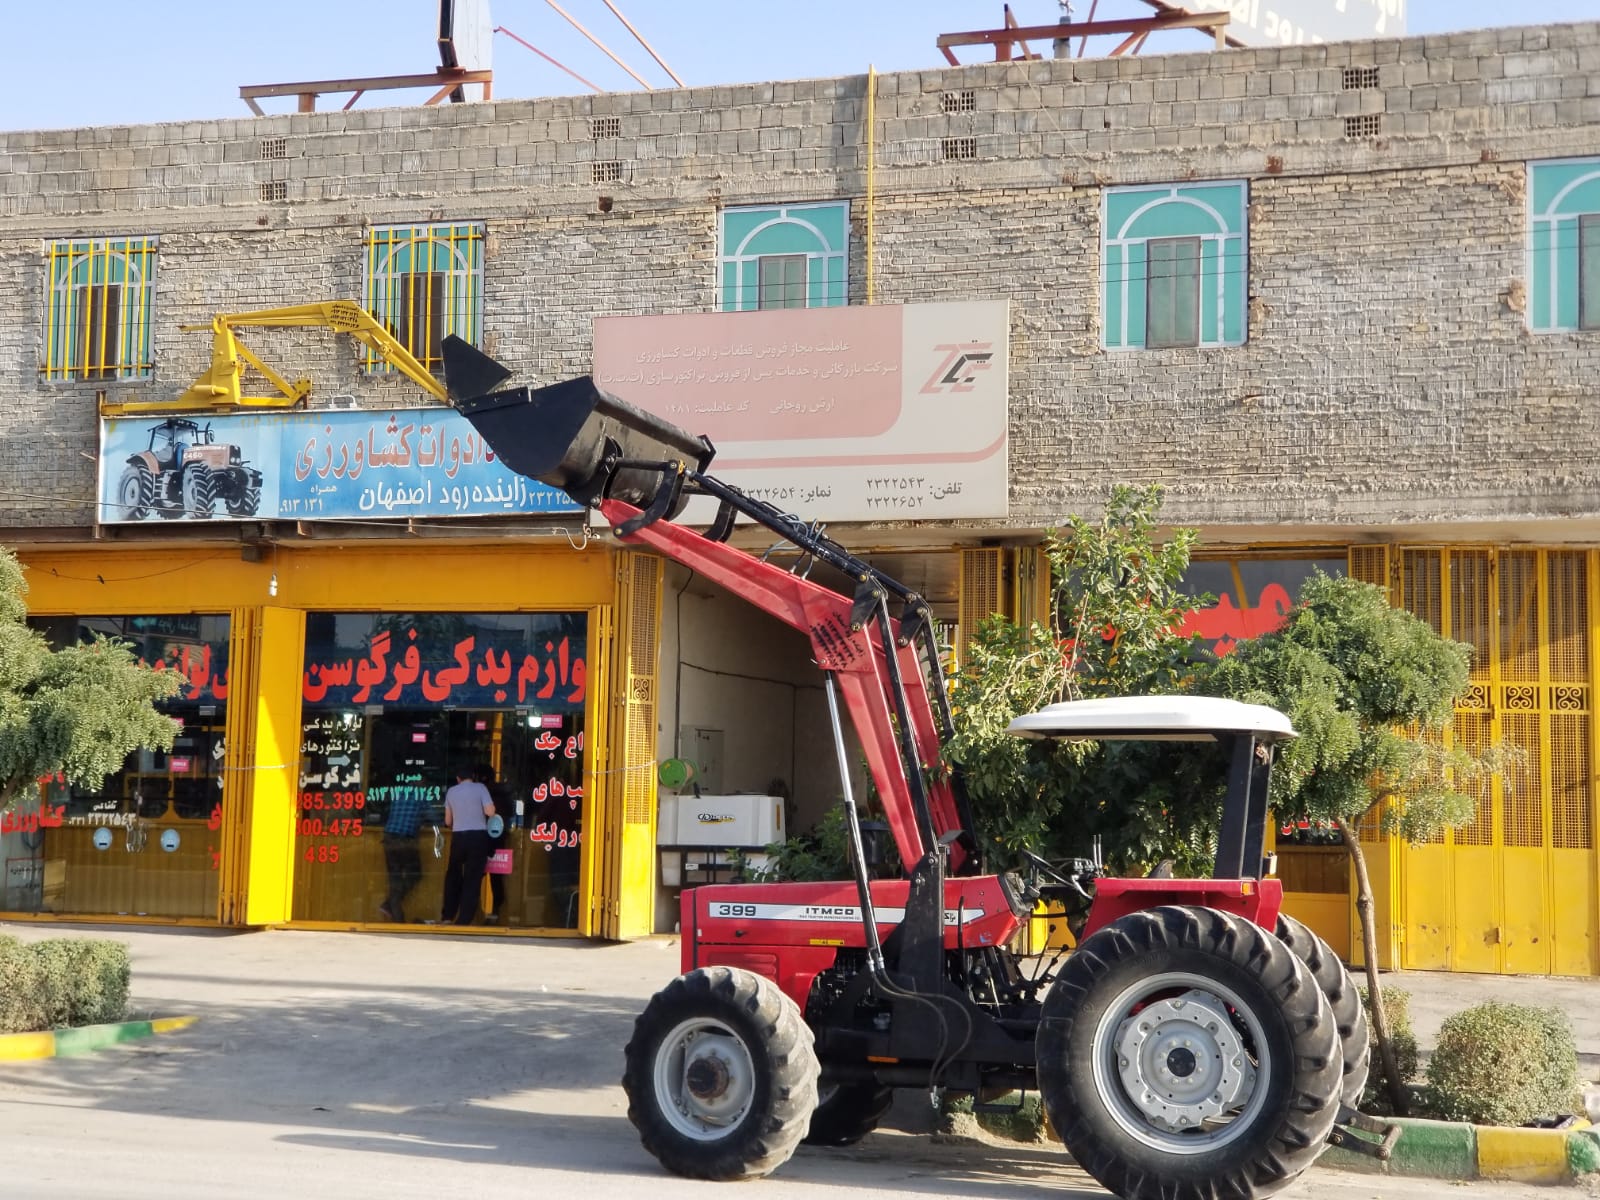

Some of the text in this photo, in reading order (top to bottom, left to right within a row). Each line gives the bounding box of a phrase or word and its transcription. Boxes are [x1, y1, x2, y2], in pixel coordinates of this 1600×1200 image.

[636, 346, 681, 363] کشاورزی
[684, 346, 711, 360] ادوات
[755, 343, 787, 359] فروش
[791, 342, 813, 357] مجاز
[709, 369, 740, 383] فروش
[742, 367, 751, 381] از
[775, 365, 810, 376] خدمات
[821, 361, 861, 379] بازرگانی
[737, 399, 752, 412] کد
[295, 414, 415, 481] کشاورزی
[310, 484, 338, 496] همراه
[866, 477, 925, 491] ۲۳۲۲۵۴۳
[929, 482, 963, 500] تلفن:
[359, 476, 527, 511] زاینده رود اصفهان
[302, 628, 420, 704] فرگوسن
[421, 635, 512, 704] یدکی
[517, 637, 587, 703] وازم
[336, 714, 363, 732] لوازم
[535, 731, 562, 759] جک
[299, 763, 361, 789] فرگوسن
[396, 772, 422, 783] همراه
[533, 777, 565, 802] های
[1, 804, 66, 834] کشاورزی
[719, 904, 854, 917] 399 ITMCO
